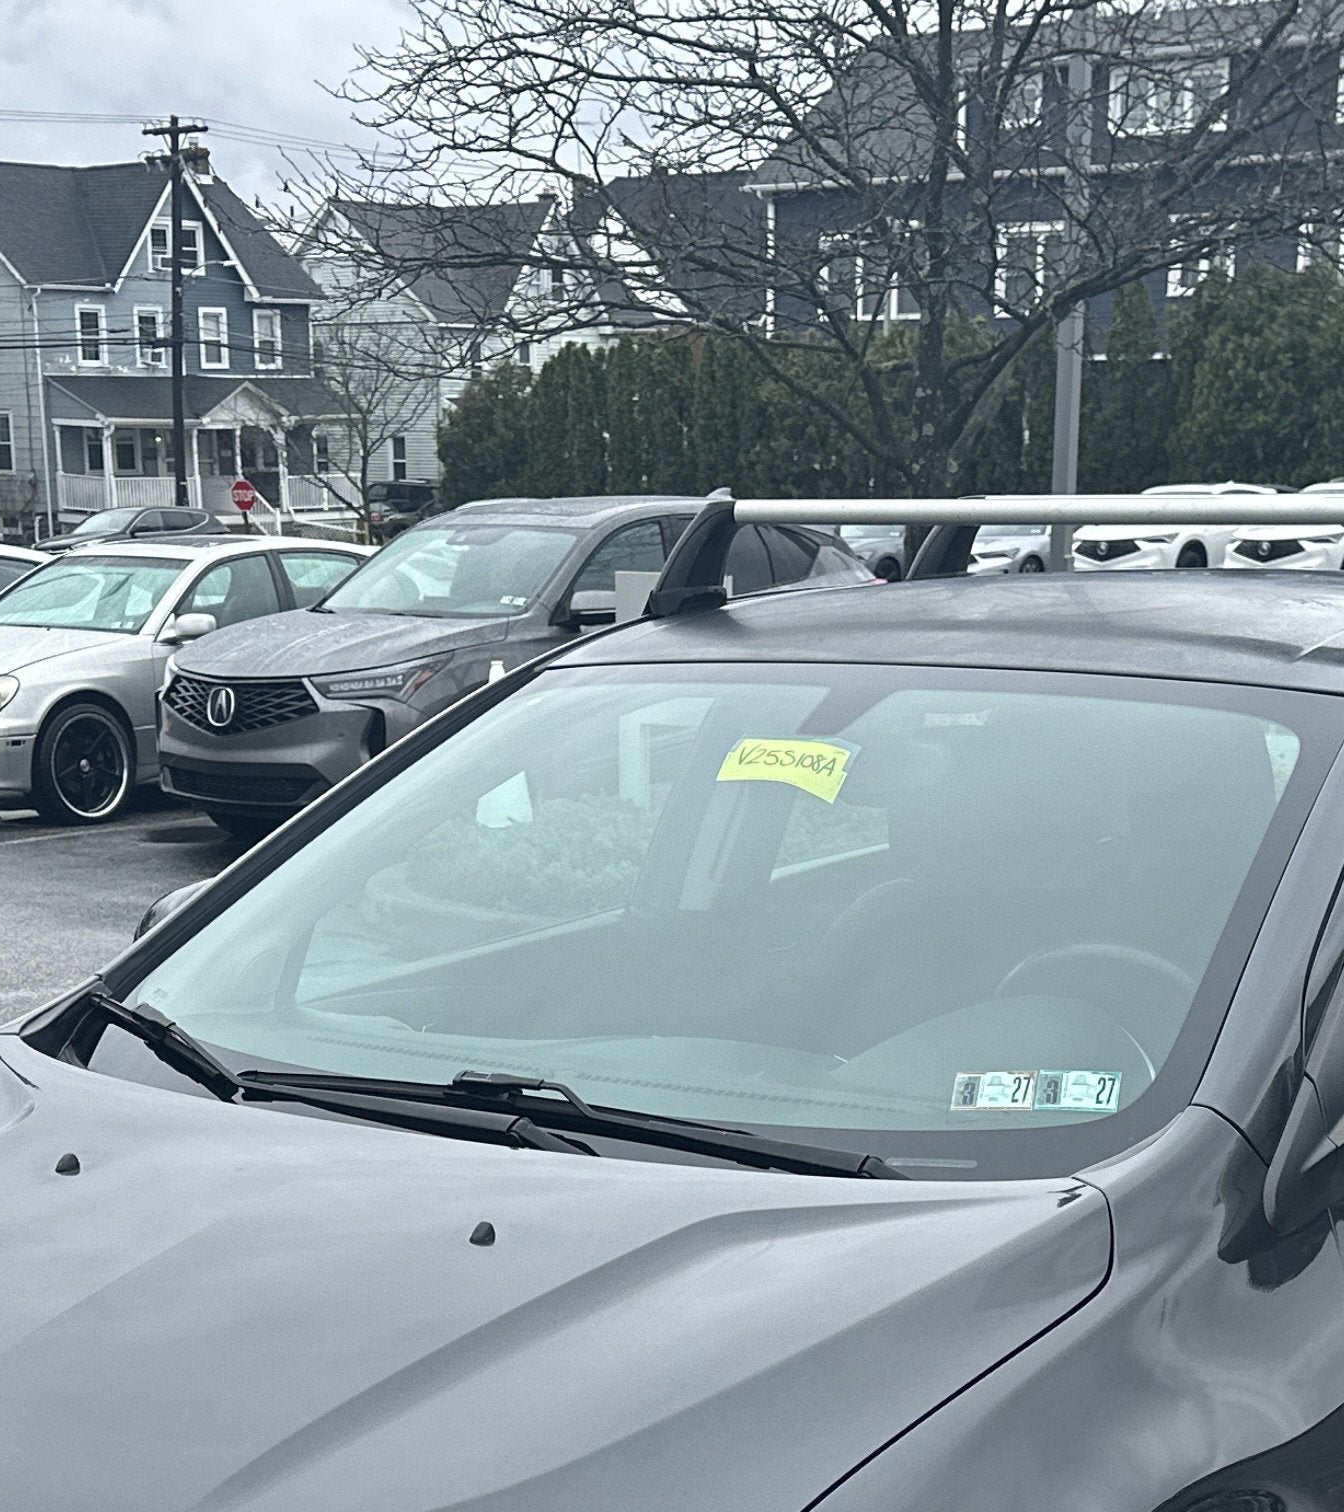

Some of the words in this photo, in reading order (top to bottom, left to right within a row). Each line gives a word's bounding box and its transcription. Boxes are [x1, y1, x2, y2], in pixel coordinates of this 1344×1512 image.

[233, 489, 254, 502] STOP
[961, 1082, 976, 1105] 3
[1011, 1076, 1031, 1104] 27
[1046, 1079, 1060, 1105] 3
[1095, 1077, 1116, 1105] 27
